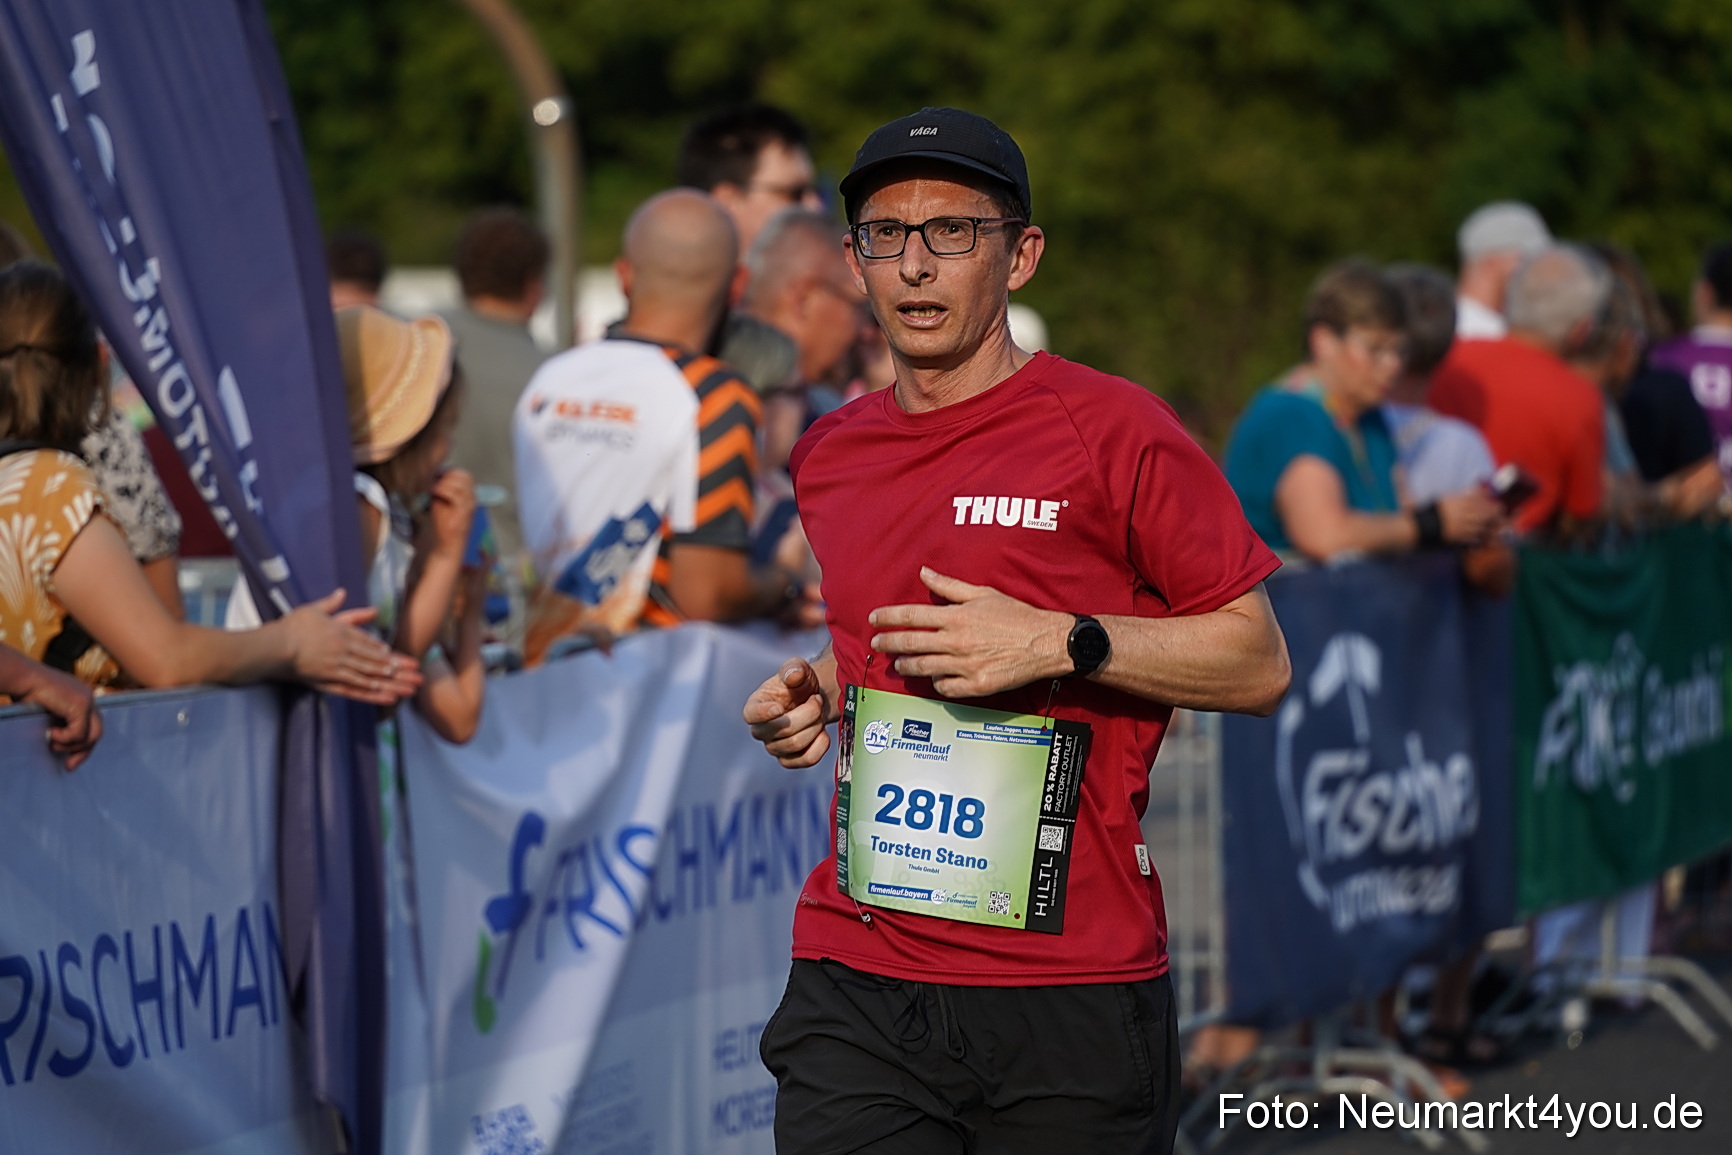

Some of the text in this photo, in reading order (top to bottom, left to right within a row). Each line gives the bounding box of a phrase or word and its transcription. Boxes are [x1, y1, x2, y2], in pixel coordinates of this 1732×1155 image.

[953, 496, 1060, 531] THULE
[1026, 519, 1054, 528] SWEDEN
[891, 738, 951, 754] Firmenlauf
[913, 752, 949, 762] neumarkt
[1043, 794, 1053, 812] 20
[1048, 732, 1063, 782] RABATT
[1054, 772, 1067, 813] FACTORY
[1061, 735, 1073, 770] OUTLET
[874, 783, 986, 839] 2818
[870, 835, 988, 870] Torsten Stano
[908, 863, 940, 875] Thule GmbH
[870, 884, 929, 899] firmenlauf.bayern
[1035, 856, 1053, 916] HILTL
